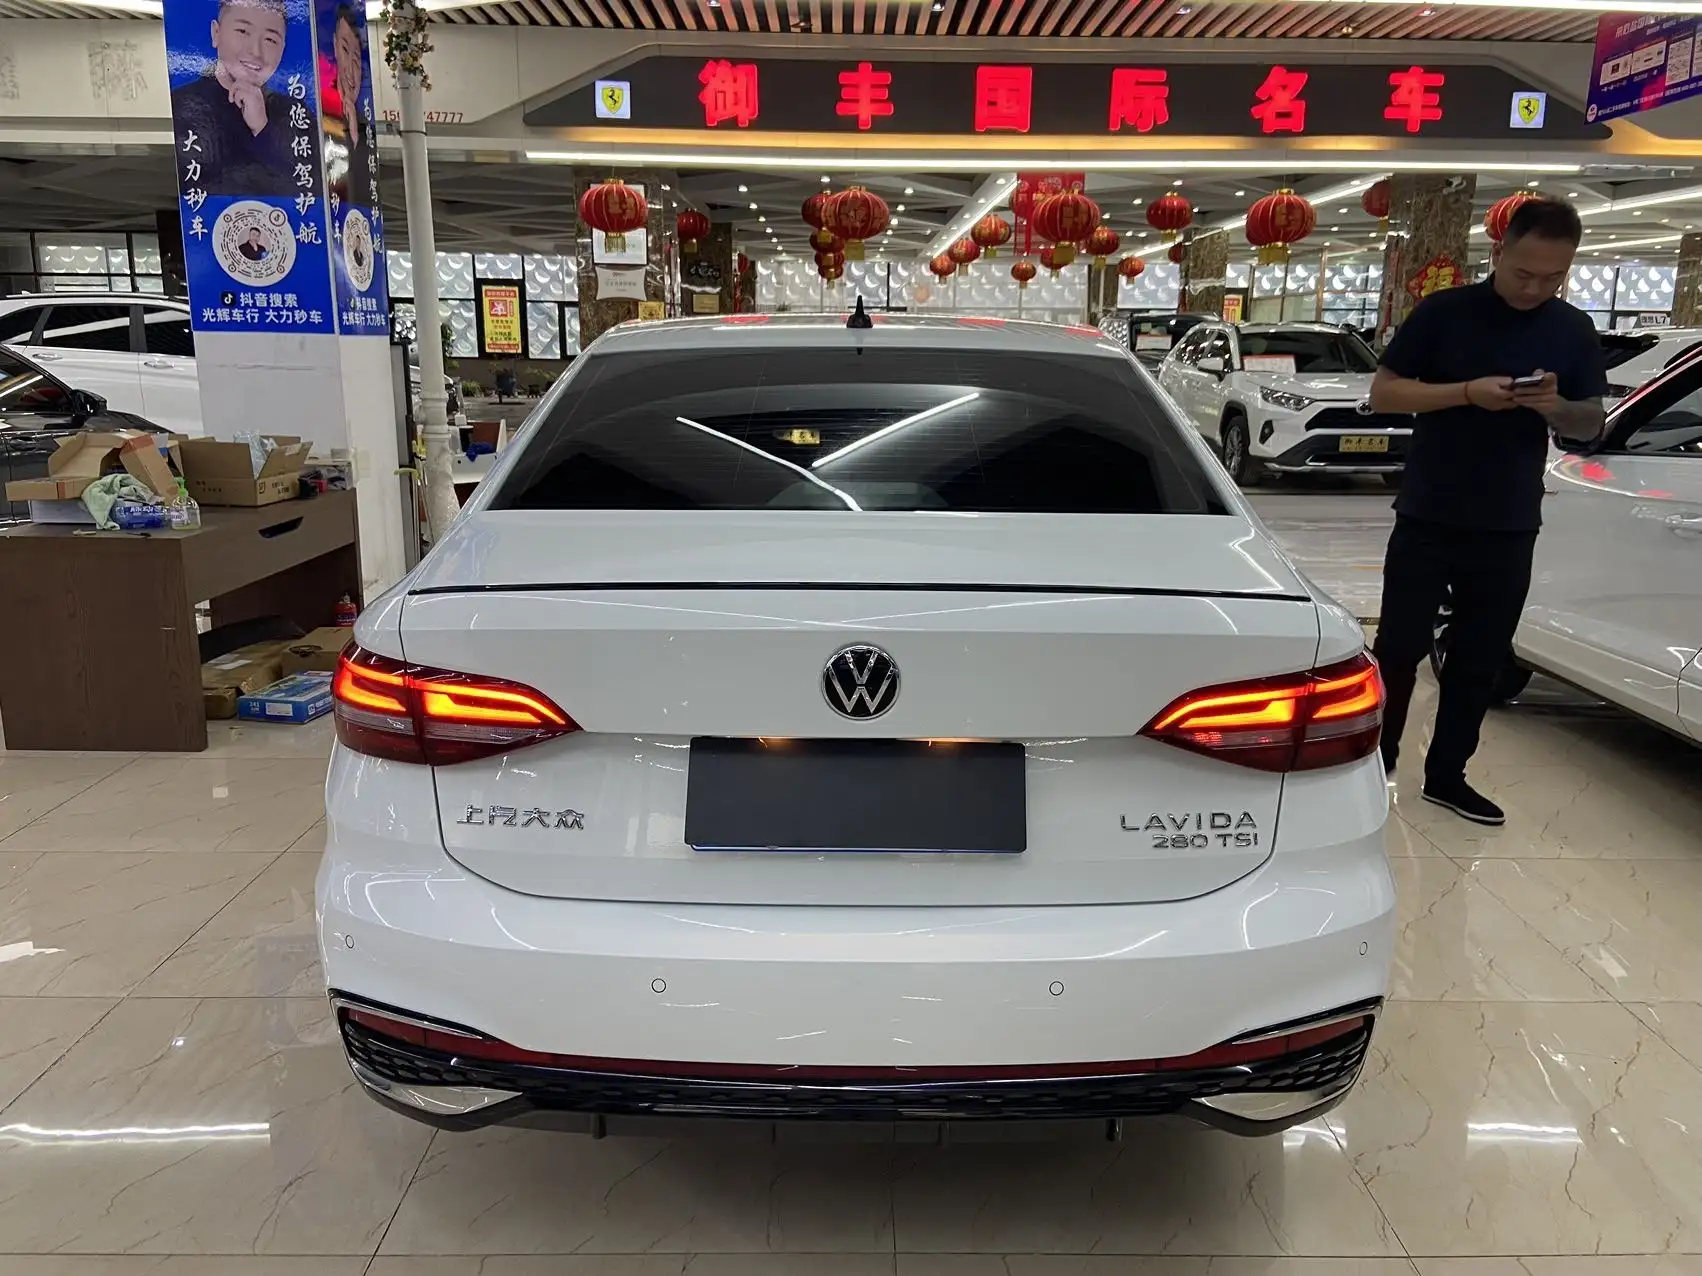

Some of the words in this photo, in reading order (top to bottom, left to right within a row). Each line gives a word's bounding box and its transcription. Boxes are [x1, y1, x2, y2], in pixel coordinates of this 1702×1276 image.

[698, 60, 1445, 133] 御丰国际名车
[382, 110, 463, 123] 1547777
[287, 73, 322, 245] 为您保驾护航
[182, 129, 208, 241] 大力秒车
[240, 292, 299, 308] 抖音搜索
[202, 308, 260, 323] 光辉车行
[264, 309, 323, 325] 大力秒车
[456, 805, 585, 830] 上汽大众
[1119, 811, 1257, 831] LAVIDA
[1152, 833, 1208, 848] 280
[1214, 832, 1259, 848] TSI
